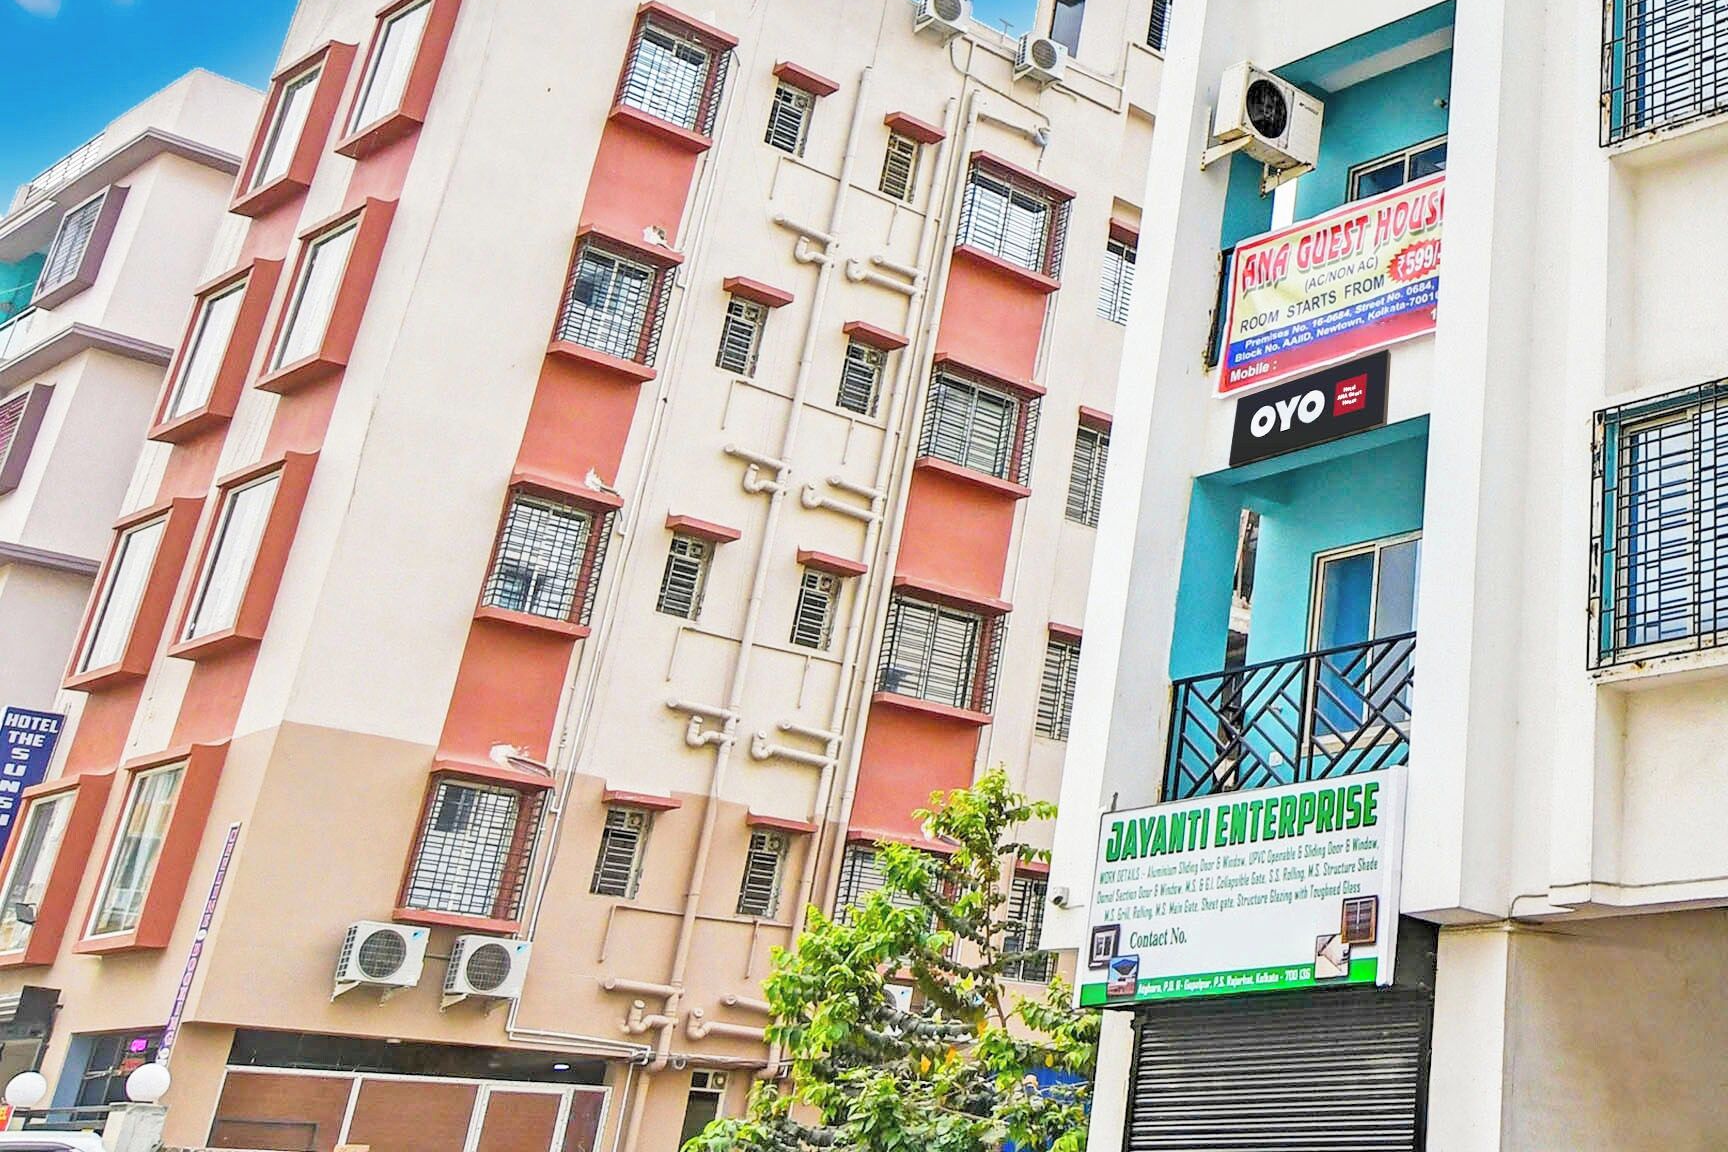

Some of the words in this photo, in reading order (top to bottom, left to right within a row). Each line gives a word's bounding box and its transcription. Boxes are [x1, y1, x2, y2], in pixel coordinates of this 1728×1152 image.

[1241, 243, 1291, 293] ANA
[1296, 214, 1368, 270] GUEST
[1374, 188, 1445, 244] HOUS
[1304, 263, 1354, 293] (AC/NON
[1357, 256, 1379, 272] AC)
[1240, 310, 1280, 333] ROOM
[1286, 290, 1337, 318] STARTS
[1345, 274, 1385, 299] FROM
[1245, 329, 1289, 349] Premises
[1292, 324, 1309, 335] No.
[1355, 299, 1385, 314] Street
[1386, 292, 1404, 304] No.
[1235, 348, 1263, 363] Block
[1265, 342, 1280, 354] No.
[1316, 317, 1365, 337] Newtown,
[1230, 361, 1270, 382] Mobile
[1250, 389, 1326, 438] OYO
[5, 713, 59, 734] HOTEL
[8, 731, 46, 747] THE
[1106, 808, 1210, 862] JAYANTI
[1215, 782, 1380, 847] ENTERPRISE
[1130, 928, 1168, 949] Contact
[1170, 926, 1187, 945] No.
